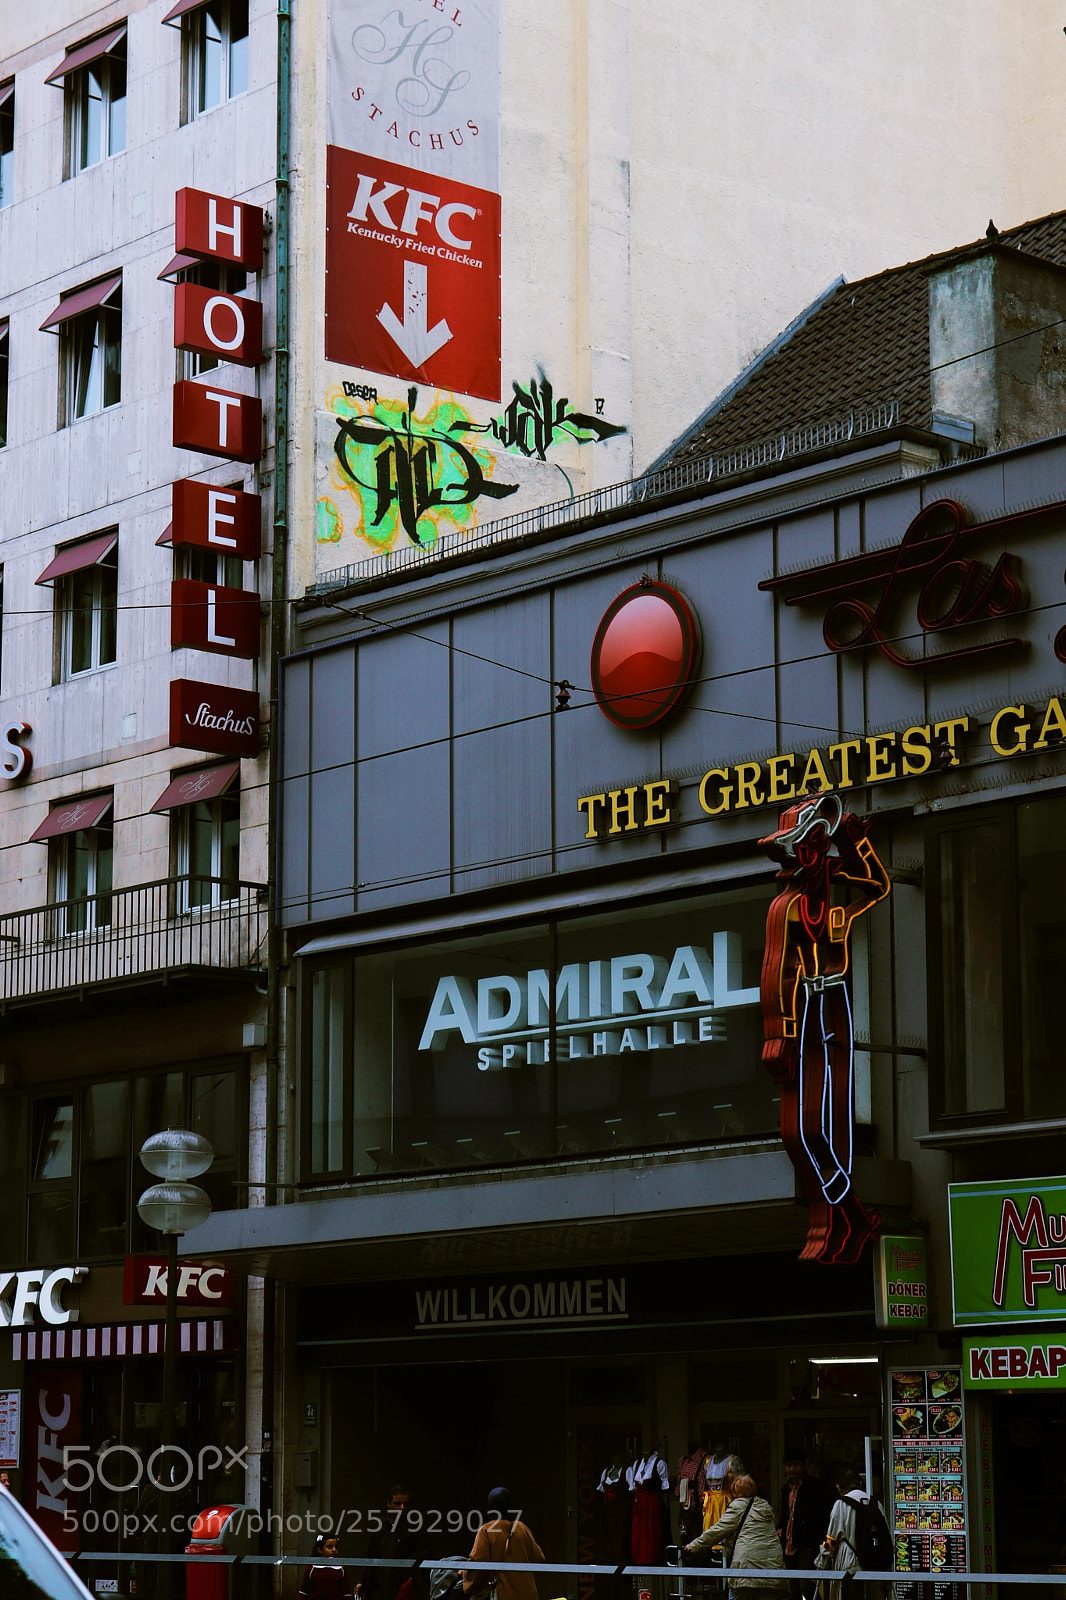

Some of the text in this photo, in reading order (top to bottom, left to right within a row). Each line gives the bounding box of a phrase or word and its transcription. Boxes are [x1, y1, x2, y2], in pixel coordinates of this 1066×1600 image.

[428, 0, 463, 27] EL
[351, 86, 480, 151] STACHUS
[347, 173, 477, 251] KFC
[347, 222, 483, 268] Kentucky Fried Chicken
[203, 199, 246, 647] HOTEL
[784, 498, 1030, 671] Las
[184, 702, 256, 736] Stachus
[1, 721, 33, 781] S
[578, 780, 674, 839] THE
[699, 717, 971, 816] GREATEST
[418, 930, 761, 1051] ADMIRAL
[477, 1016, 727, 1072] SPIELHALLE
[142, 1265, 226, 1299] KFC
[415, 1277, 627, 1324] WILLKOMMEN
[888, 1280, 926, 1298] DÖNER
[889, 1303, 927, 1318] KEBAP
[970, 1346, 1066, 1379] KEBAP
[36, 1388, 71, 1516] KFC
[981, 1419, 992, 1509] KEBAP
